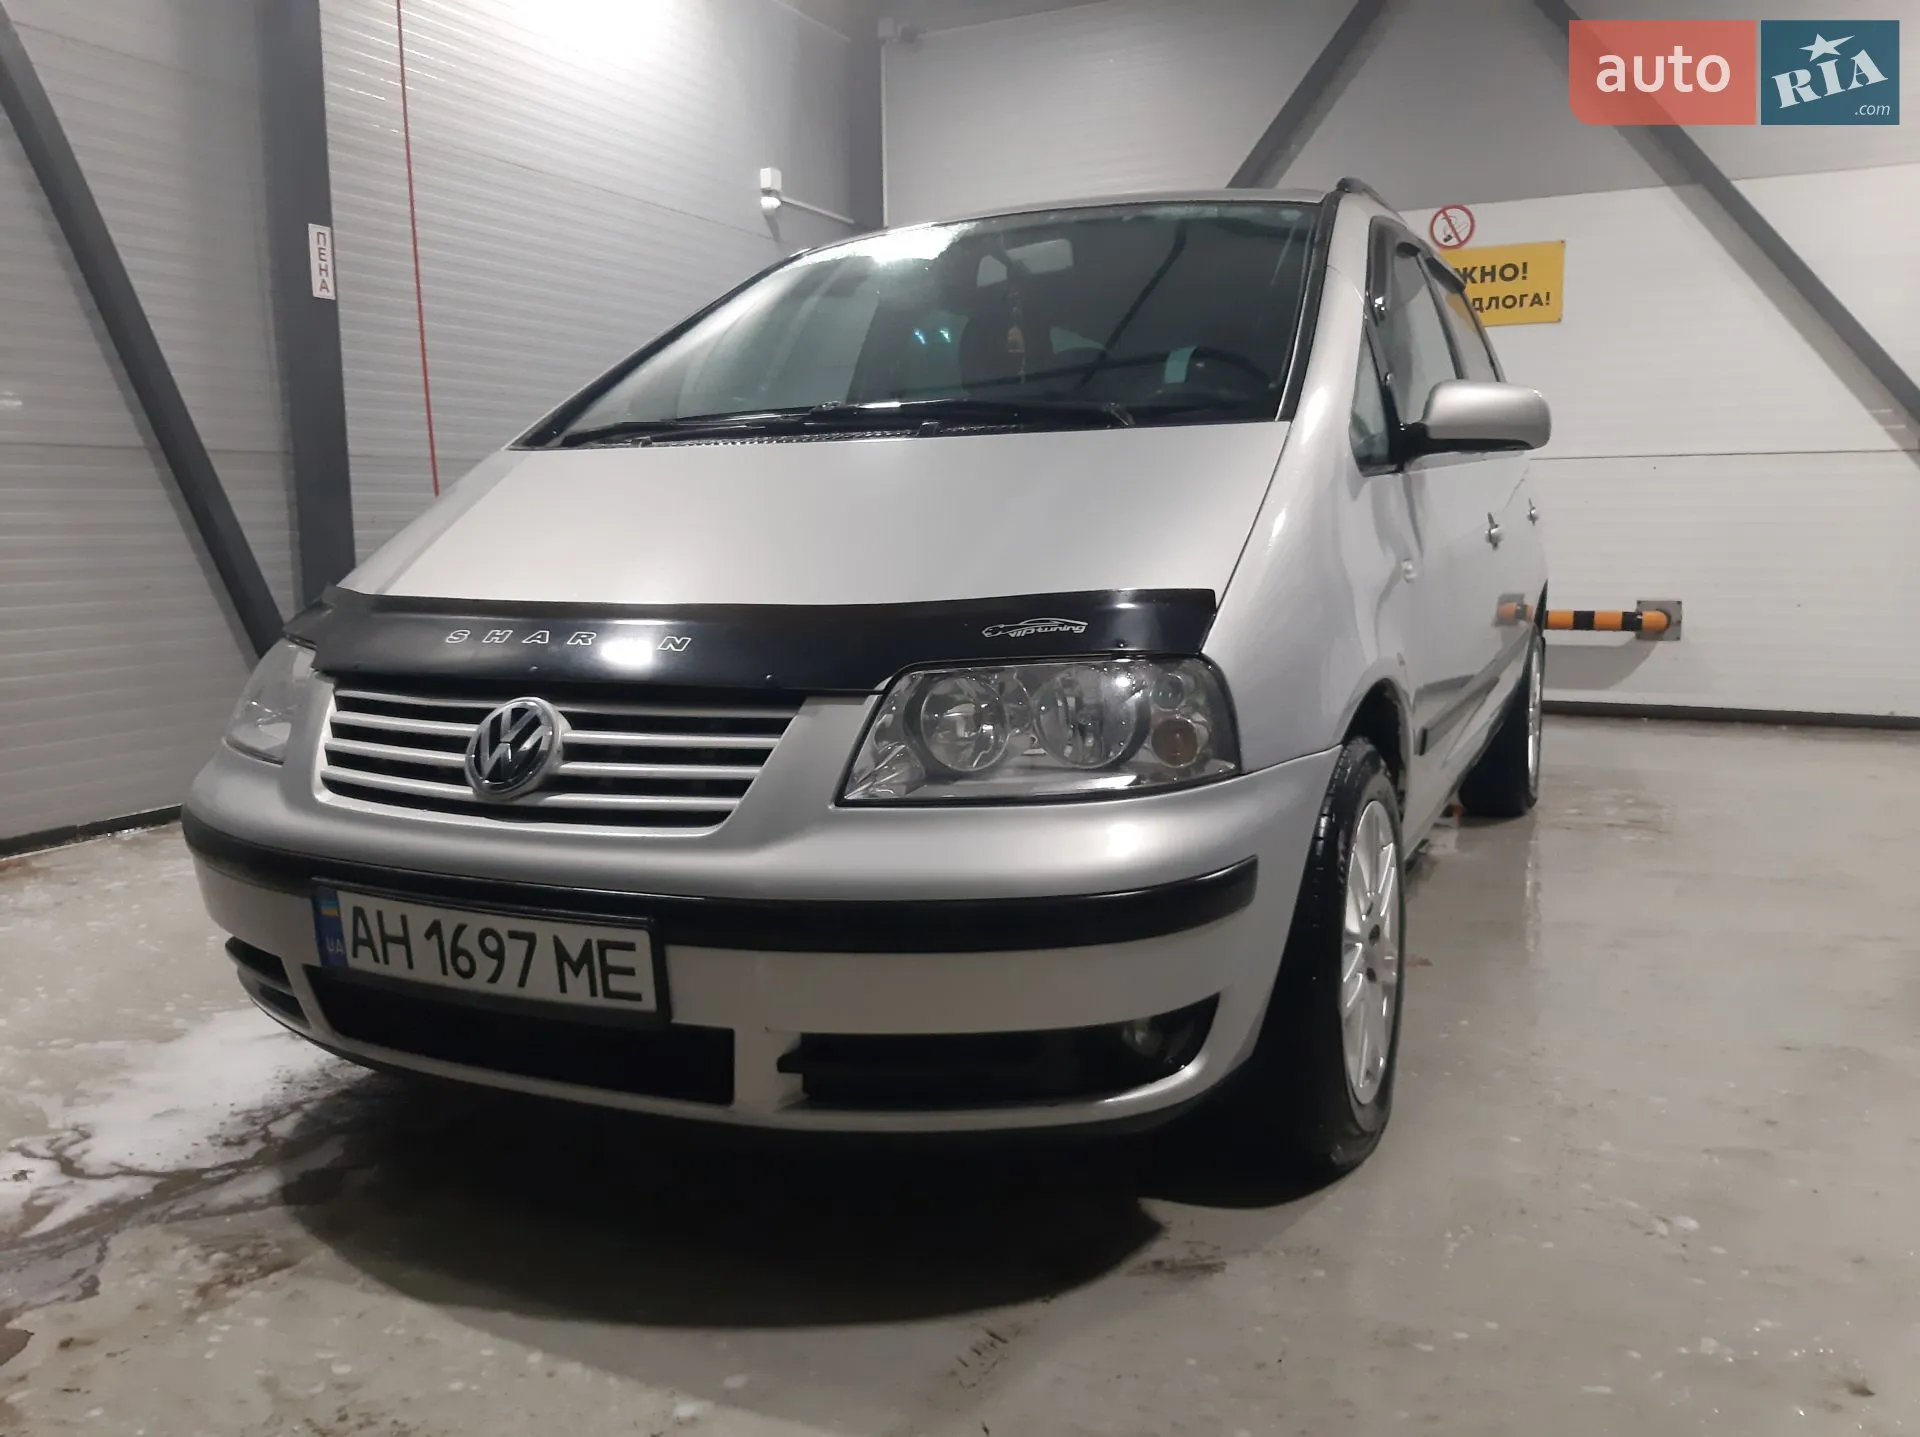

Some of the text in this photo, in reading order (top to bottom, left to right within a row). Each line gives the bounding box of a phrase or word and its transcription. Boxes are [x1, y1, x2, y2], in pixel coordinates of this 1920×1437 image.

[316, 231, 330, 293] ПЕНА
[446, 629, 692, 651] SHARN
[325, 939, 344, 955] UA
[352, 905, 643, 1002] AH 1697 ME
